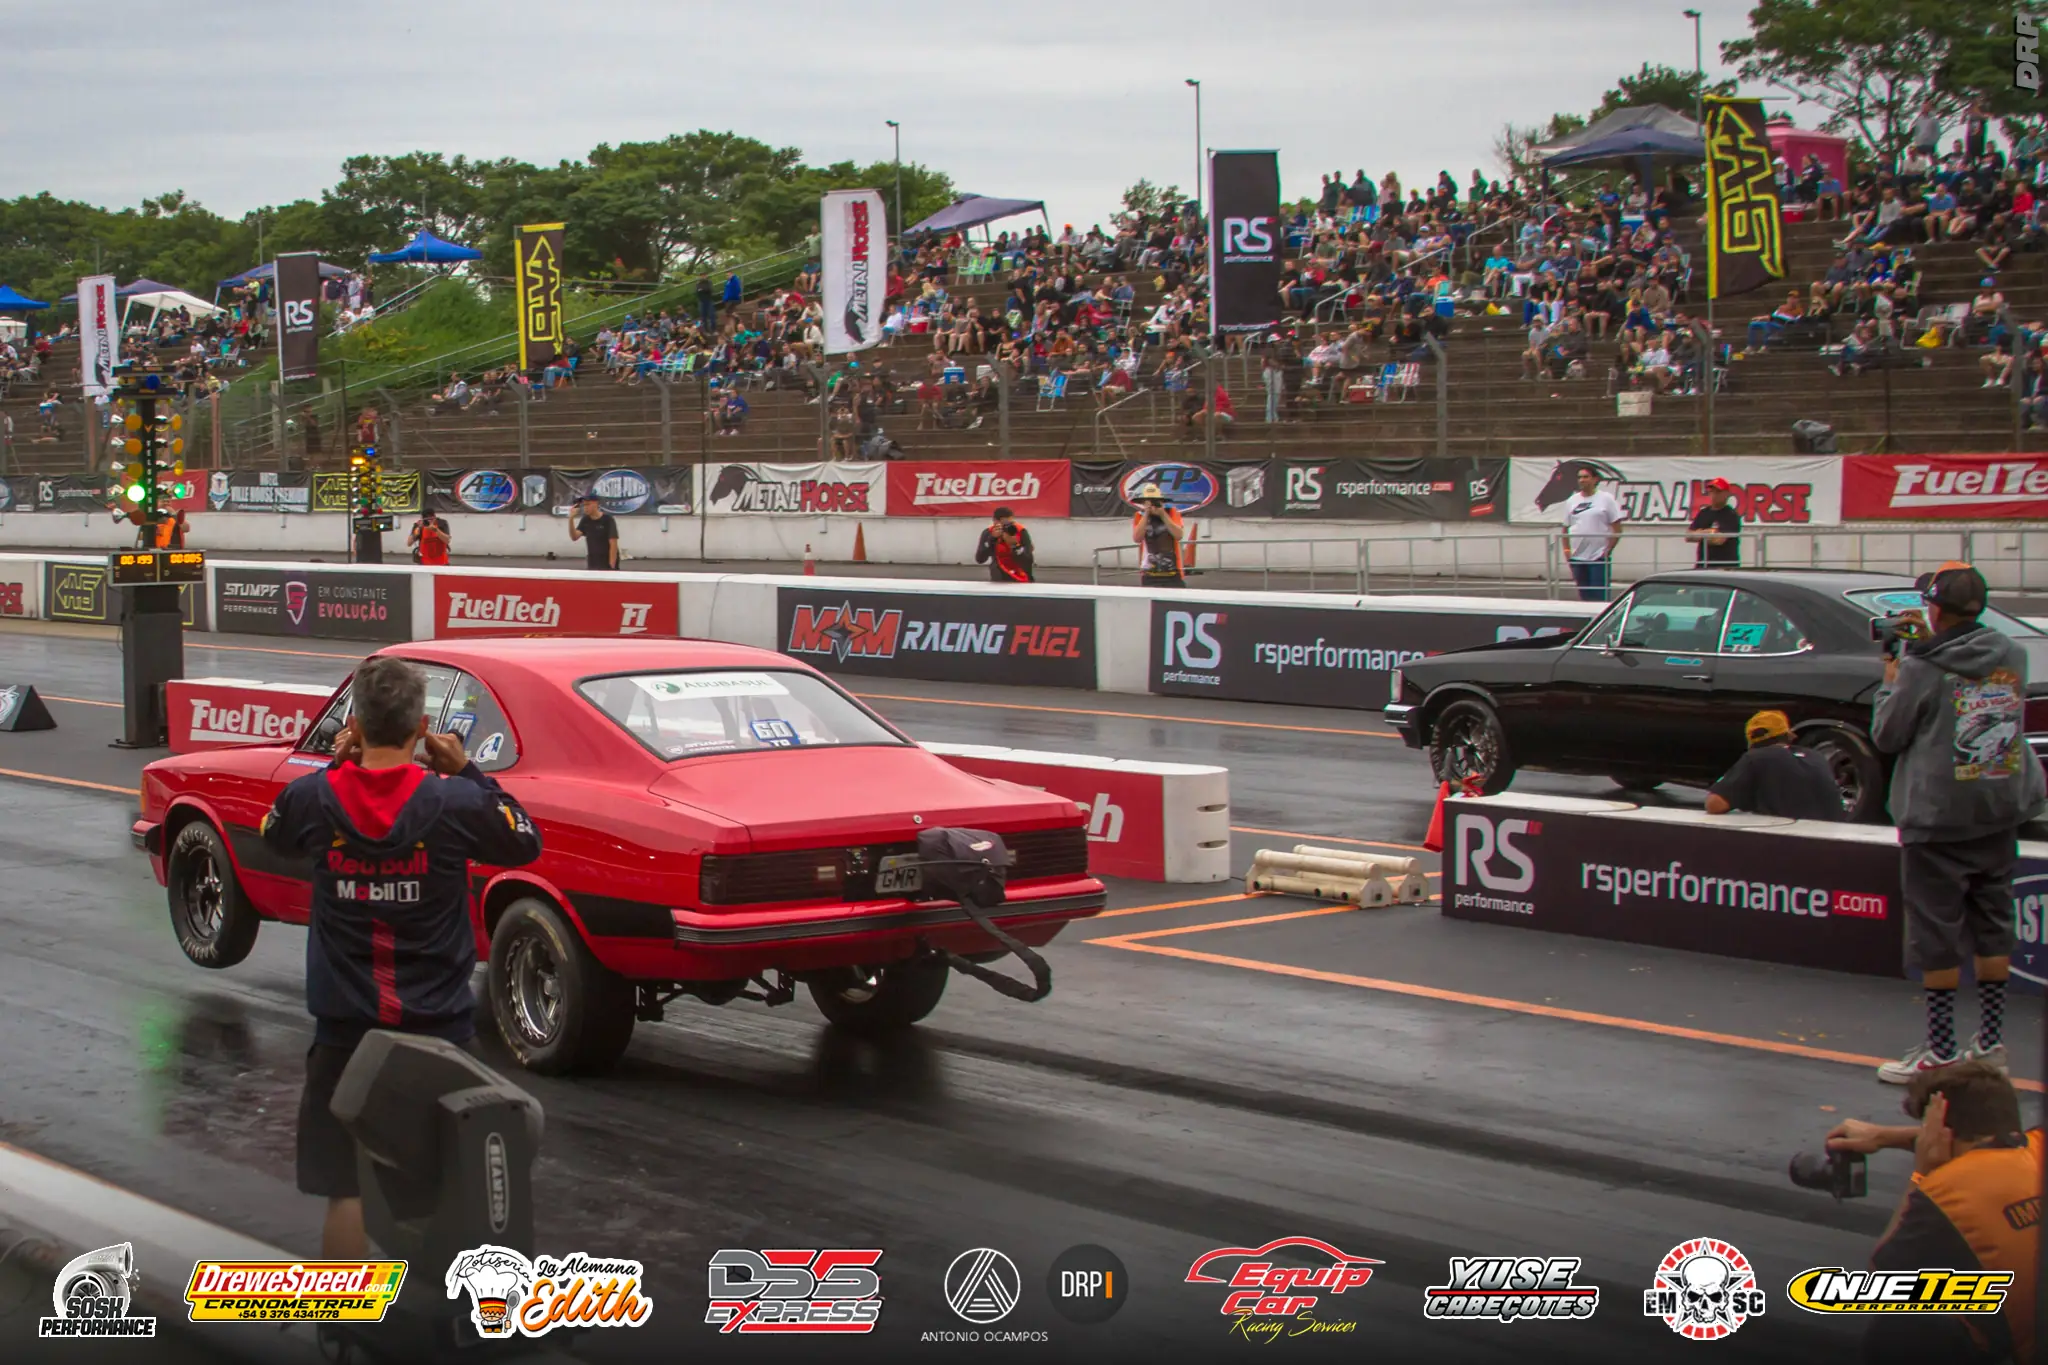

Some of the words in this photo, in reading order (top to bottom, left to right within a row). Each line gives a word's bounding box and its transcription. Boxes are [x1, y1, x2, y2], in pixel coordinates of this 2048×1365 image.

[1223, 217, 1274, 254] RS
[285, 300, 314, 327] RS
[732, 479, 870, 513] METALHORSE
[914, 472, 1040, 505] FuelTech
[1286, 466, 1325, 501] RS
[1470, 479, 1491, 498] RS
[223, 582, 280, 597] STUMPF
[318, 586, 330, 598] EM
[332, 587, 388, 600] CONSTANTE
[223, 604, 278, 615] PERFORMANCE
[318, 601, 388, 622] EVOLUÇÃO
[447, 591, 561, 628] FuelTech
[620, 602, 653, 634] FT
[902, 620, 1008, 655] RACING
[1009, 623, 1082, 659] FUEL
[1163, 610, 1224, 670] RS
[1163, 670, 1221, 686] performance
[1454, 813, 1540, 894] RS
[337, 880, 395, 900] Mobil
[1454, 892, 1534, 915] performance
